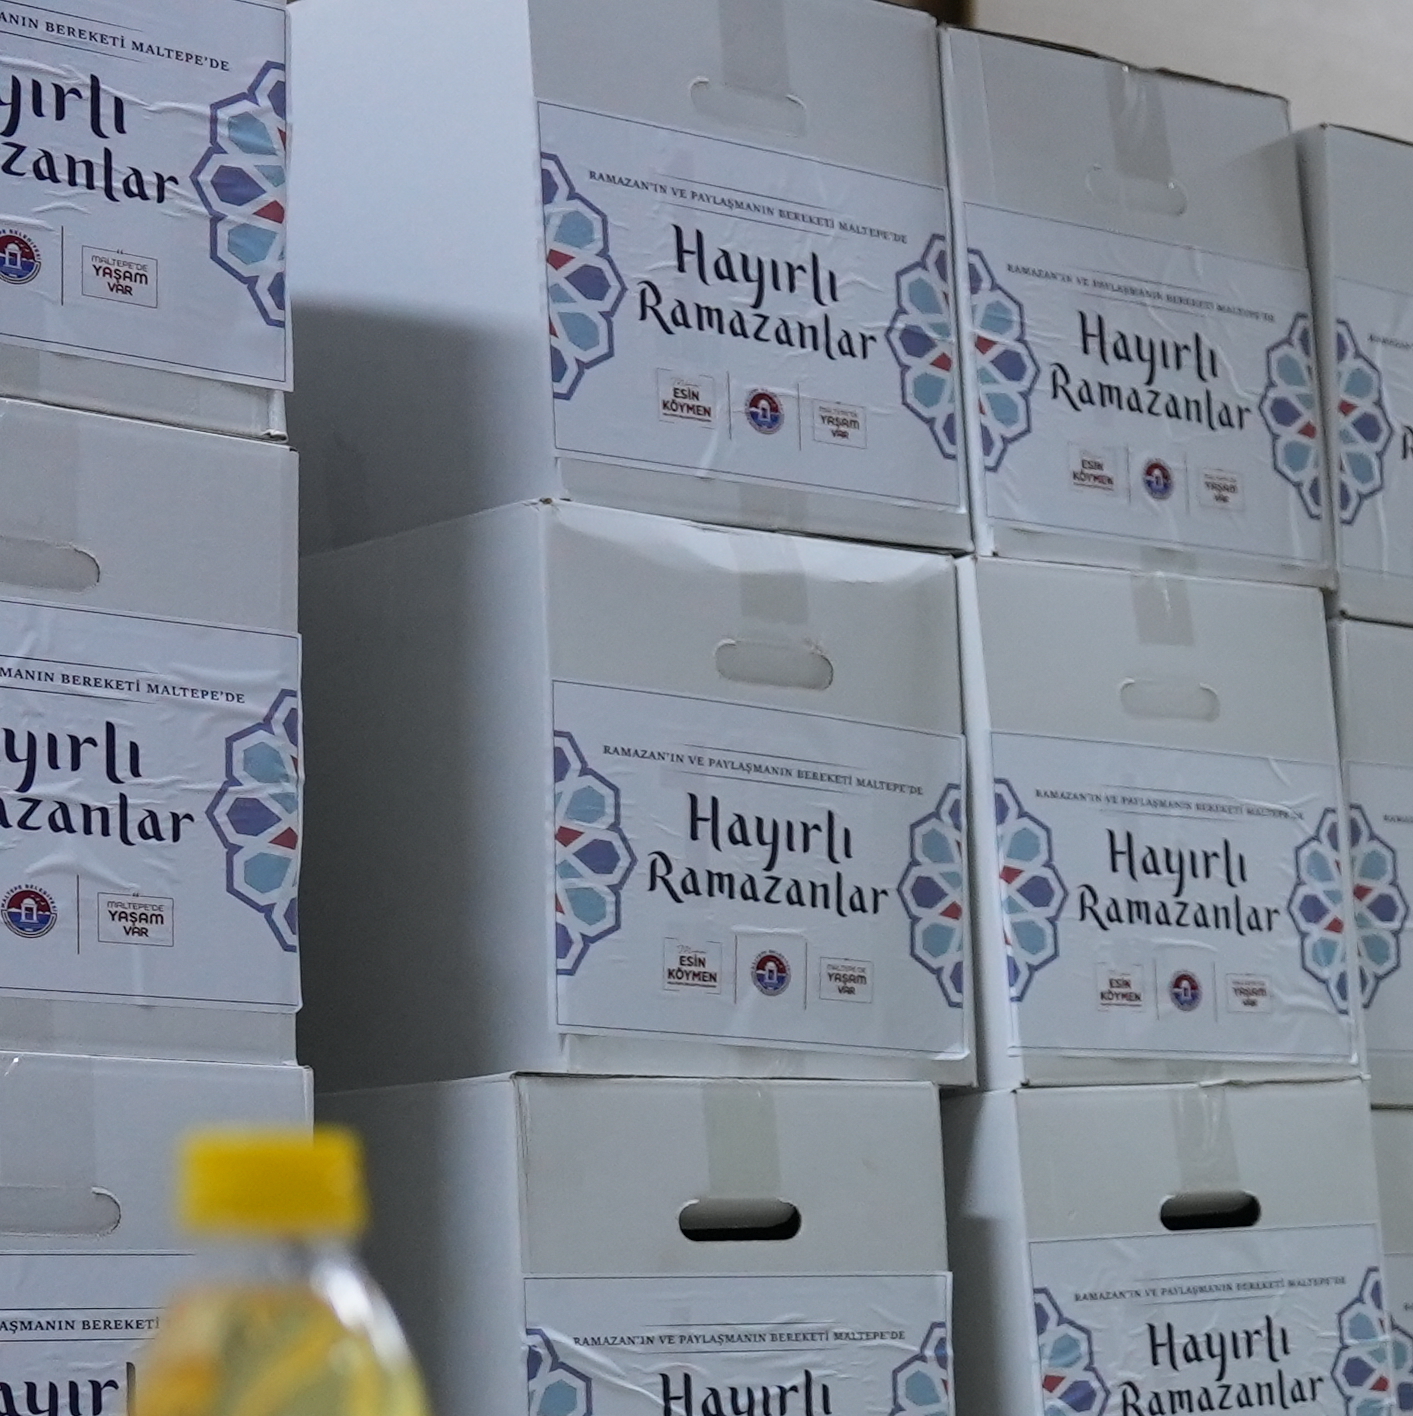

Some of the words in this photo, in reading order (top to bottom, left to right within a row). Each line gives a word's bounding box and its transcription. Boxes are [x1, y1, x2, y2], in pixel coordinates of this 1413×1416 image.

[45, 20, 126, 49] BEREKETİ
[0, 72, 127, 138] yırlı
[0, 141, 180, 203] zanlar
[92, 264, 148, 285] YAŞAM
[672, 223, 840, 309] Hayırlı
[107, 281, 133, 296] VAR
[636, 280, 878, 361] Ramazanlar
[1078, 310, 1218, 386] Hayırlı
[662, 398, 712, 417] KÖYMEN
[1051, 363, 1252, 432] Ramazanlar
[60, 671, 141, 693] BEREKETİ
[146, 681, 245, 704] MALTEPE'DE
[2, 720, 141, 793] yırlı
[688, 755, 705, 767] VE
[687, 792, 854, 872] Hayırlı
[1107, 828, 1248, 897] Hayırlı
[647, 850, 890, 917] Ramazanlar
[108, 910, 164, 926] YAŞAM
[1077, 884, 1281, 936] Ramazanlar
[123, 926, 149, 938] VAR
[667, 965, 718, 983] KÖYMEN
[679, 954, 706, 968] ESİN
[826, 972, 868, 986] YAŞAM
[837, 986, 857, 996] VAR
[0, 1318, 76, 1334] AŞMANIN
[82, 1316, 161, 1331] BEREKETİ
[659, 1334, 676, 1345] VE
[679, 1332, 768, 1347] PAYLAŞMANIN
[1146, 1315, 1291, 1382] Hayırlı
